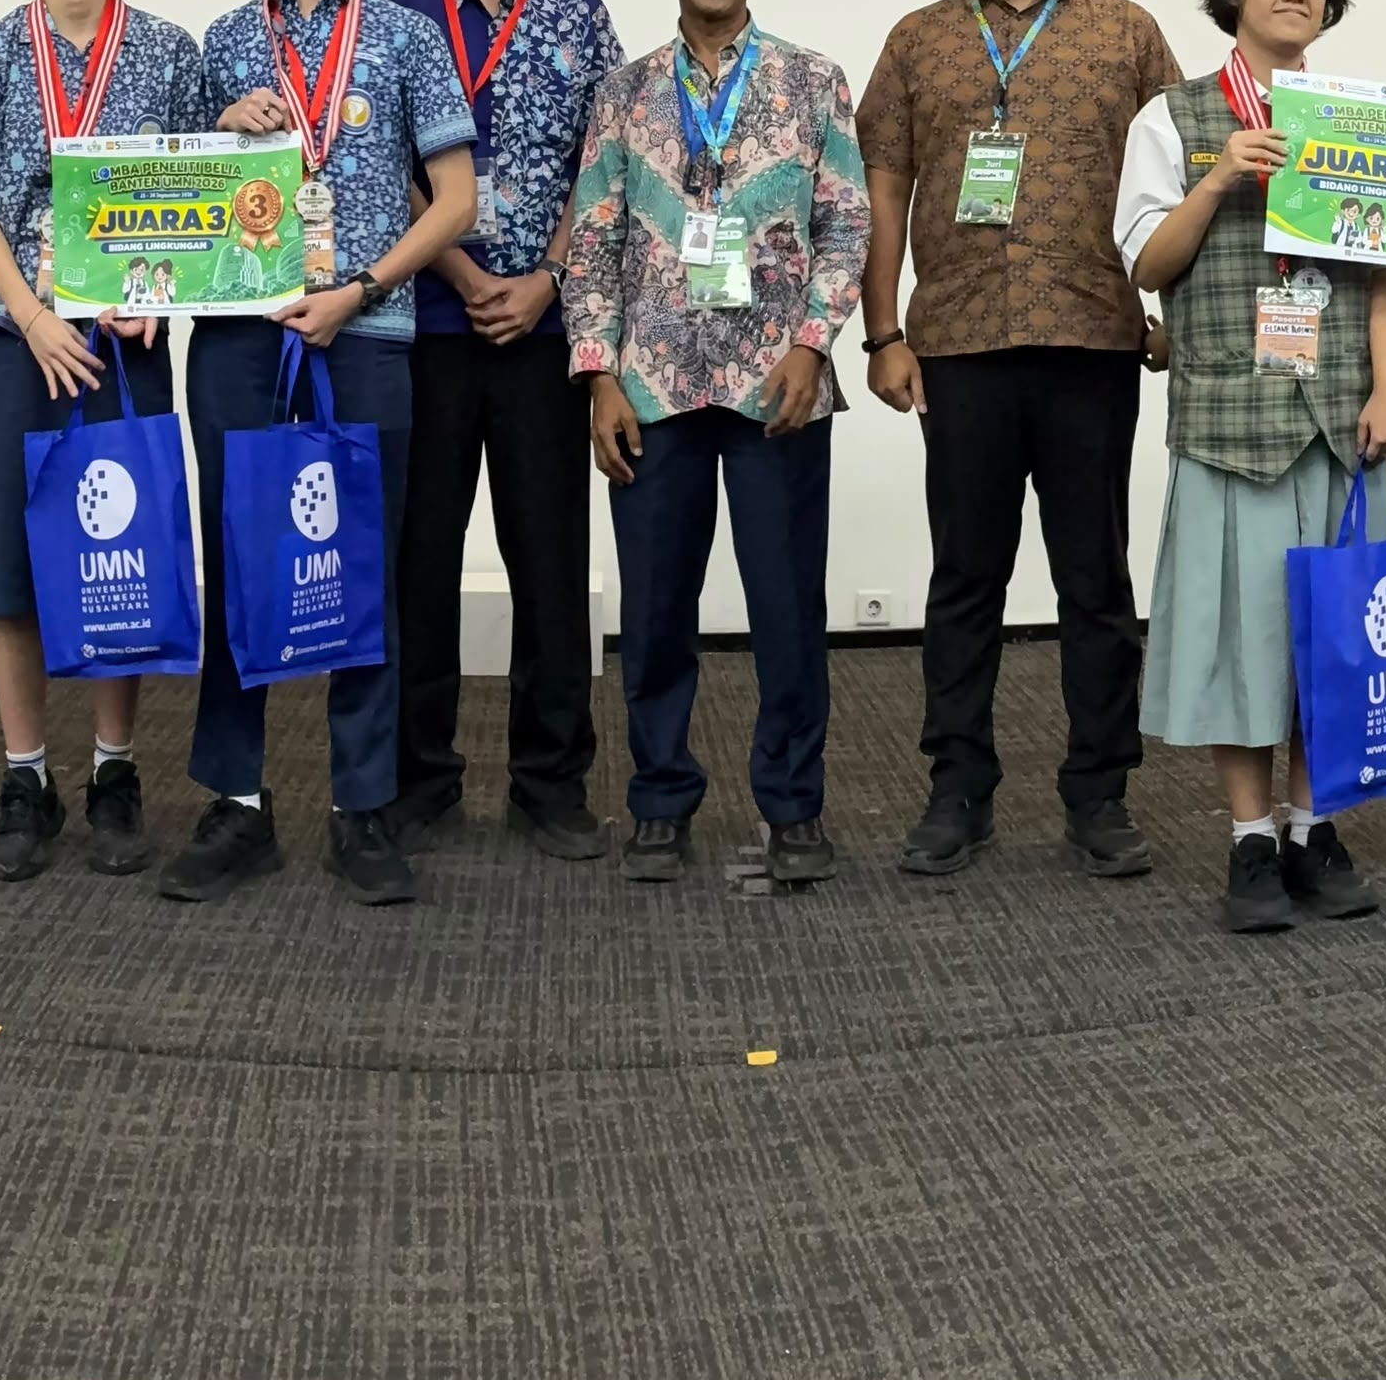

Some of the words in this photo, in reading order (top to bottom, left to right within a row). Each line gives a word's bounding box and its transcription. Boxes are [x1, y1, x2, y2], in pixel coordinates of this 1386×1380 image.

[1333, 120, 1385, 135] BANTEN
[142, 160, 201, 174] PENELITI
[204, 161, 243, 177] BELIA
[985, 160, 1002, 168] Juri
[110, 176, 160, 192] BANTEN
[163, 177, 192, 188] UMN
[194, 178, 226, 189] 2026
[1319, 180, 1358, 194] BIDANG
[248, 194, 268, 220] 3
[98, 208, 204, 234] JUARA
[206, 205, 227, 230] 3
[108, 241, 144, 252] BIDANG
[145, 240, 208, 252] LINGKUNGAN
[714, 241, 727, 250] uri
[1271, 315, 1307, 324] Peserta
[1264, 325, 1290, 333] ELIANE
[79, 548, 145, 583] UMN
[294, 548, 342, 586] UMN
[81, 582, 148, 595] UNIVERSITAS
[292, 581, 342, 599] UNIVERSITA
[81, 592, 149, 604] MULTIMEDIA
[292, 590, 342, 608] MULTIMEDI
[82, 601, 150, 613] NUSANTARA
[292, 598, 343, 617] NUSANTAR
[83, 618, 152, 633] www.umn.ac.id
